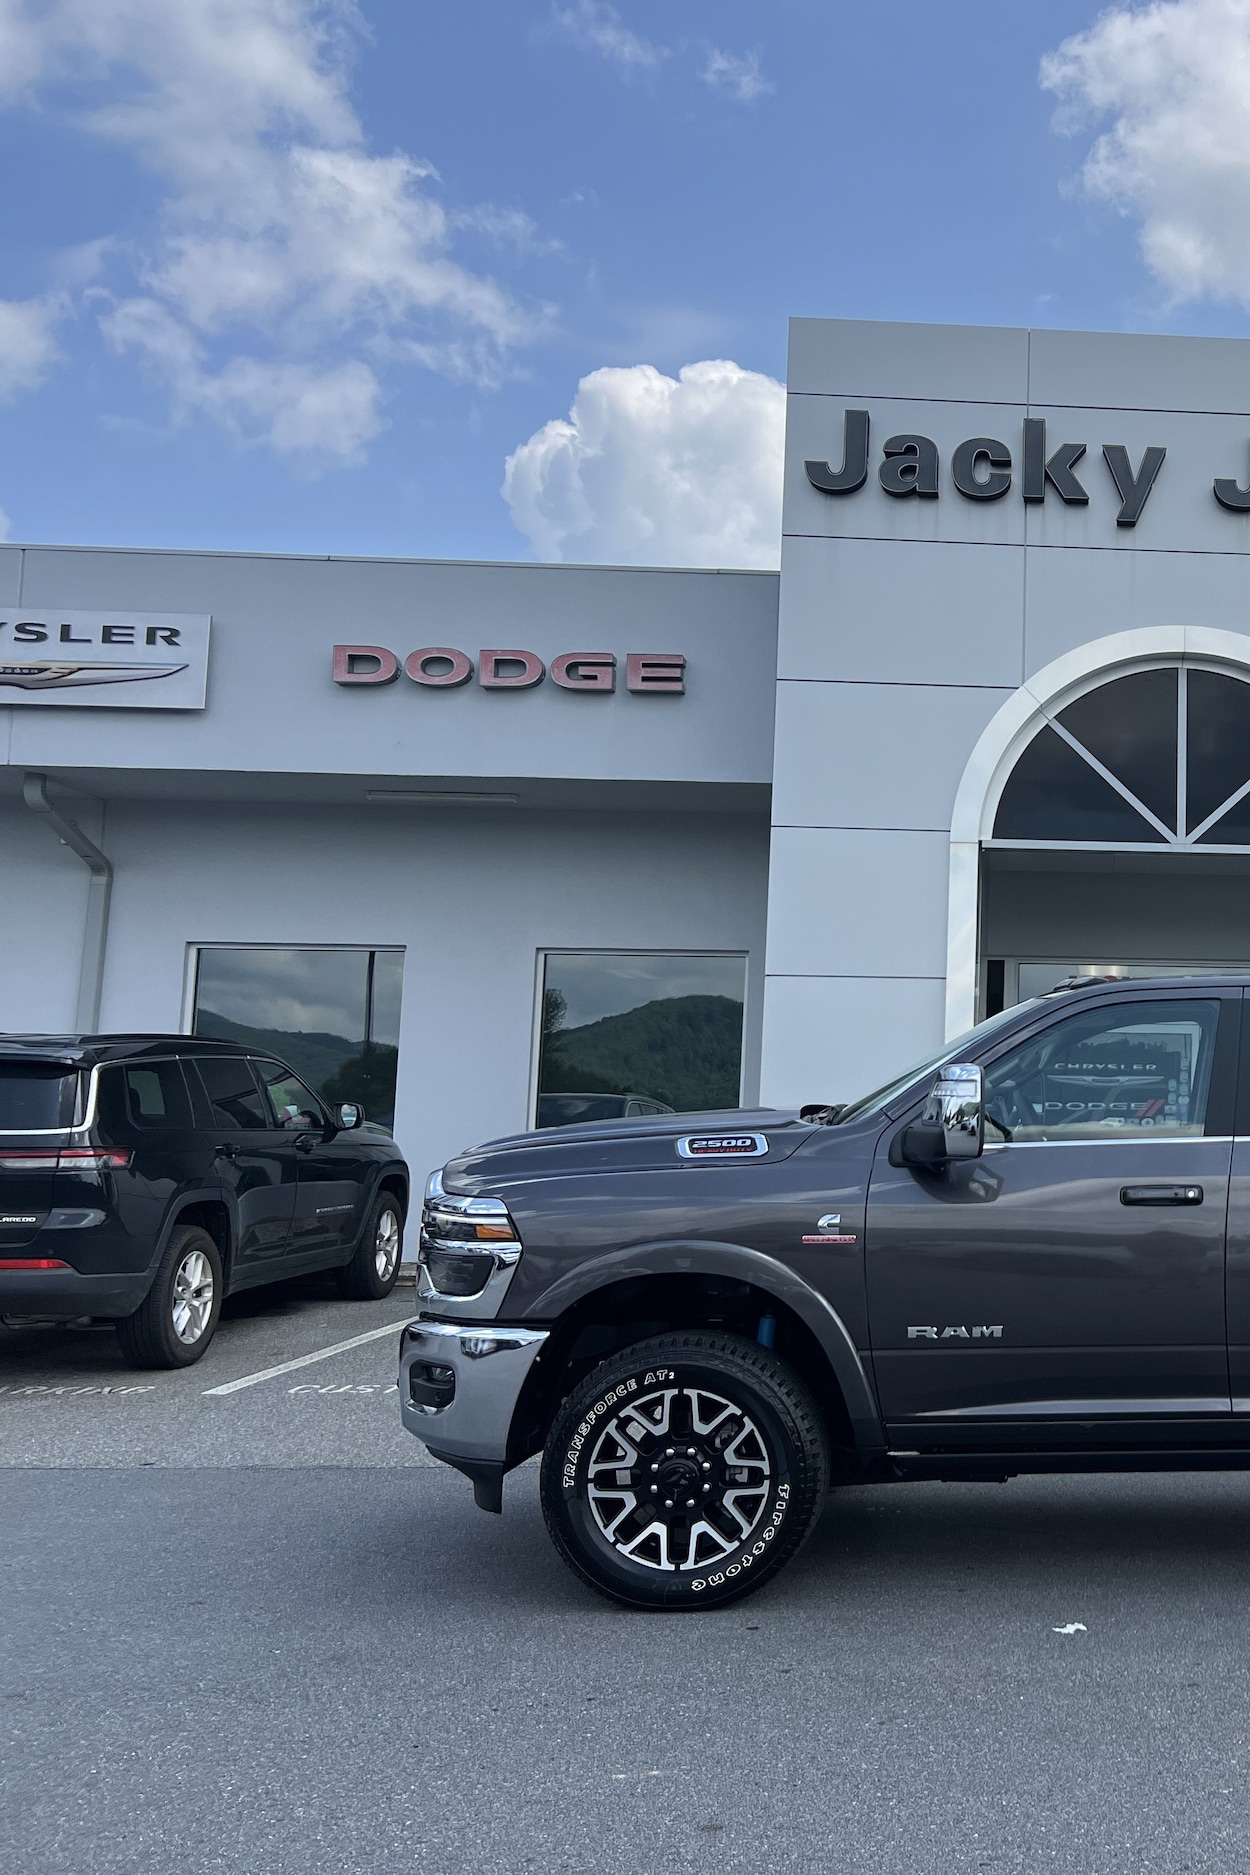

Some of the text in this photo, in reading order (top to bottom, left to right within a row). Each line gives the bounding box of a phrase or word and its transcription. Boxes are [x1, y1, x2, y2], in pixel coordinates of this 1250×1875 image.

[804, 409, 1168, 527] Jacky
[0, 621, 182, 646] SLER
[332, 644, 687, 695] DODGE
[1054, 1062, 1158, 1071] CHRYSLER
[1044, 1101, 1149, 1111] DODGE
[692, 1138, 752, 1148] 2500
[0, 1215, 37, 1223] AREDO
[907, 1325, 1004, 1339] RAM
[563, 1379, 637, 1488] TRANSFORCE
[691, 1484, 790, 1591] Firestone
